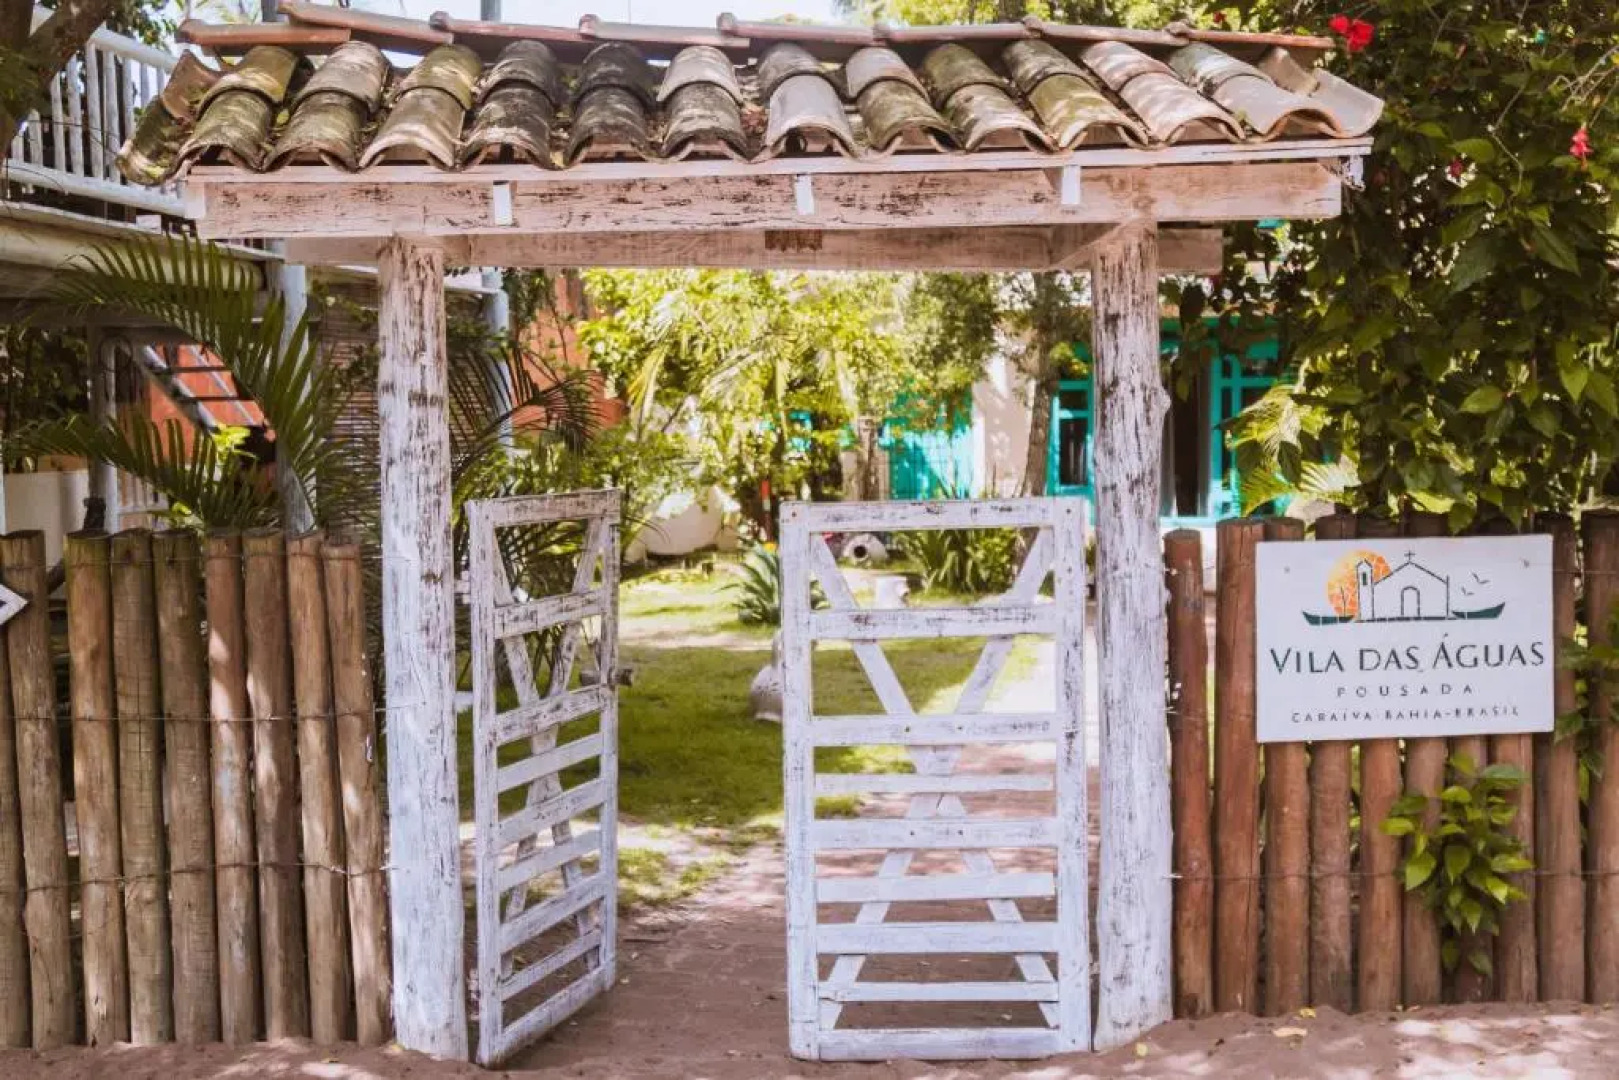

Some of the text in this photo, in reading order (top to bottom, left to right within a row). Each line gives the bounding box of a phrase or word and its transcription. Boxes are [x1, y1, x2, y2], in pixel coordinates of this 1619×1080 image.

[1270, 633, 1545, 674] VILA DAS ÁGUAS
[1337, 683, 1473, 698] POUSADA
